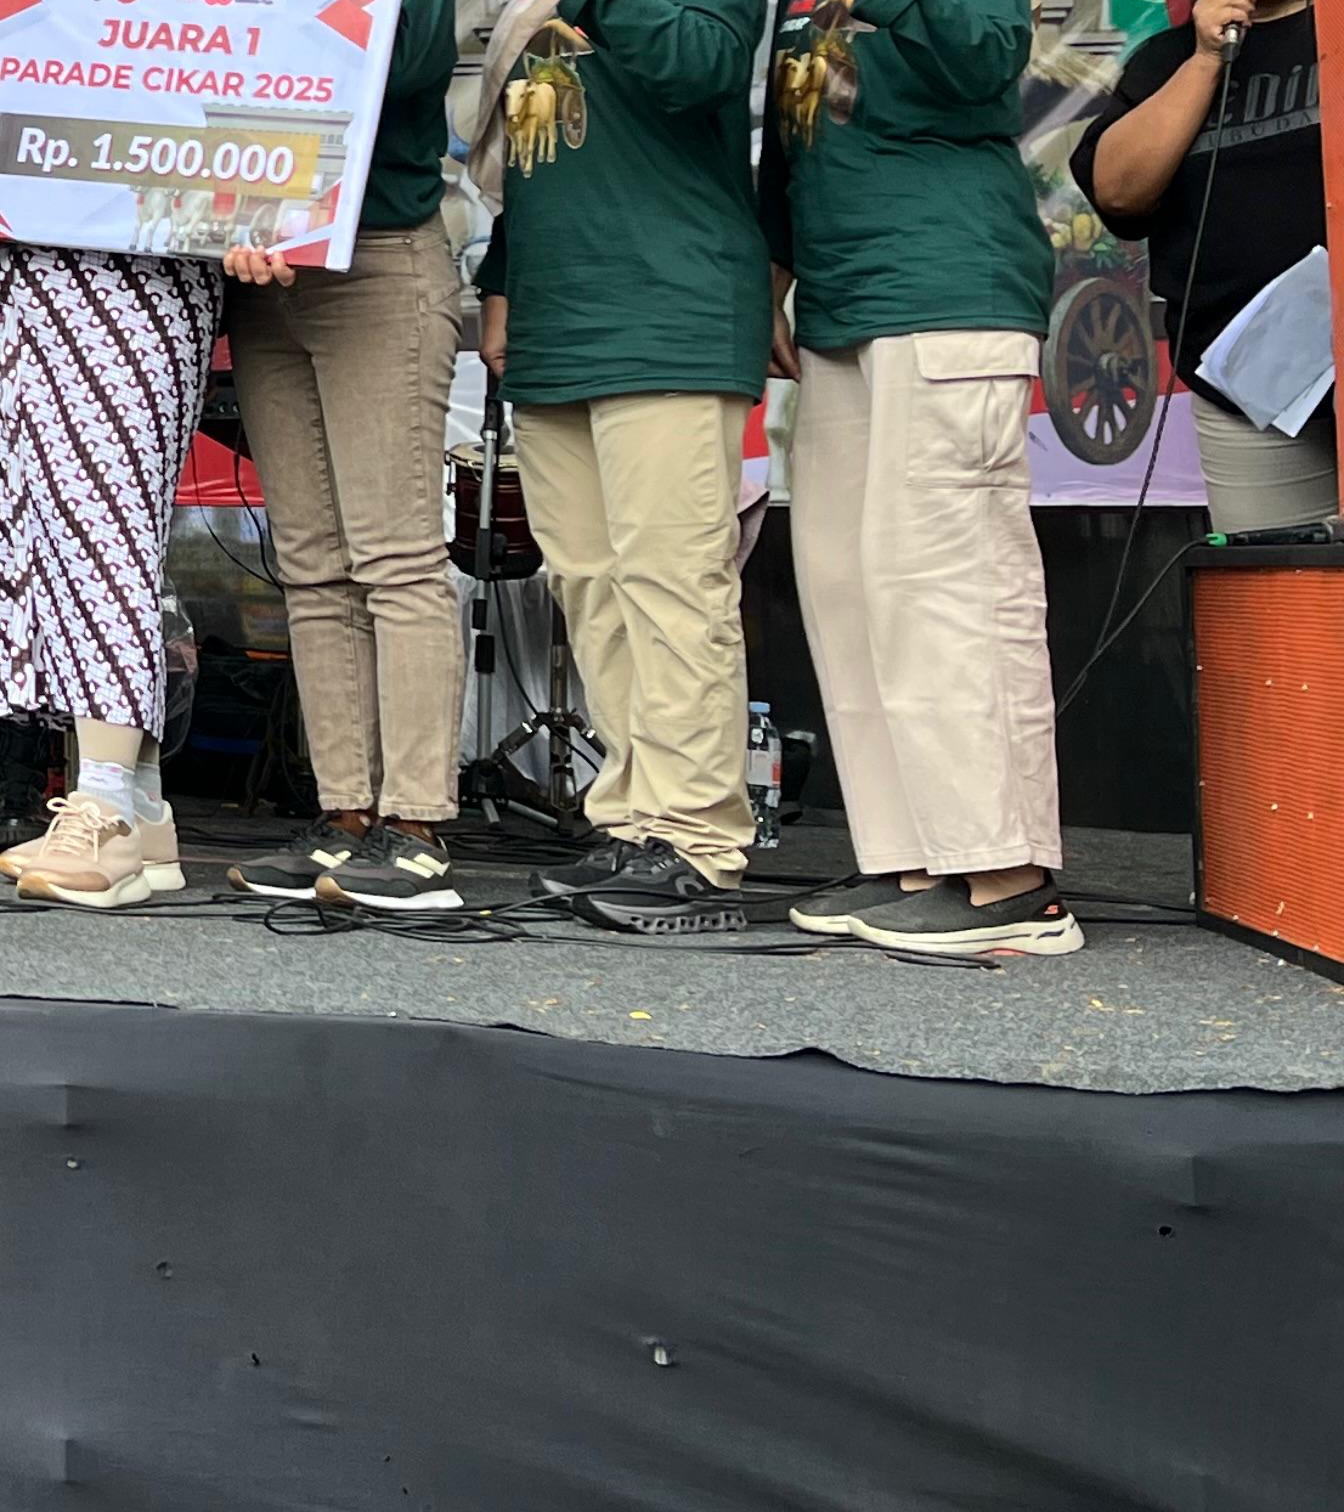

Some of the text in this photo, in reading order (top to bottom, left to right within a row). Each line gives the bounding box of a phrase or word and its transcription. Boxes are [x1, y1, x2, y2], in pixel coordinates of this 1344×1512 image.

[97, 19, 261, 57] JUARA 1
[142, 66, 245, 99] CIKAR
[253, 73, 334, 103] 2025
[17, 126, 296, 186] Rp. 1.500.000
